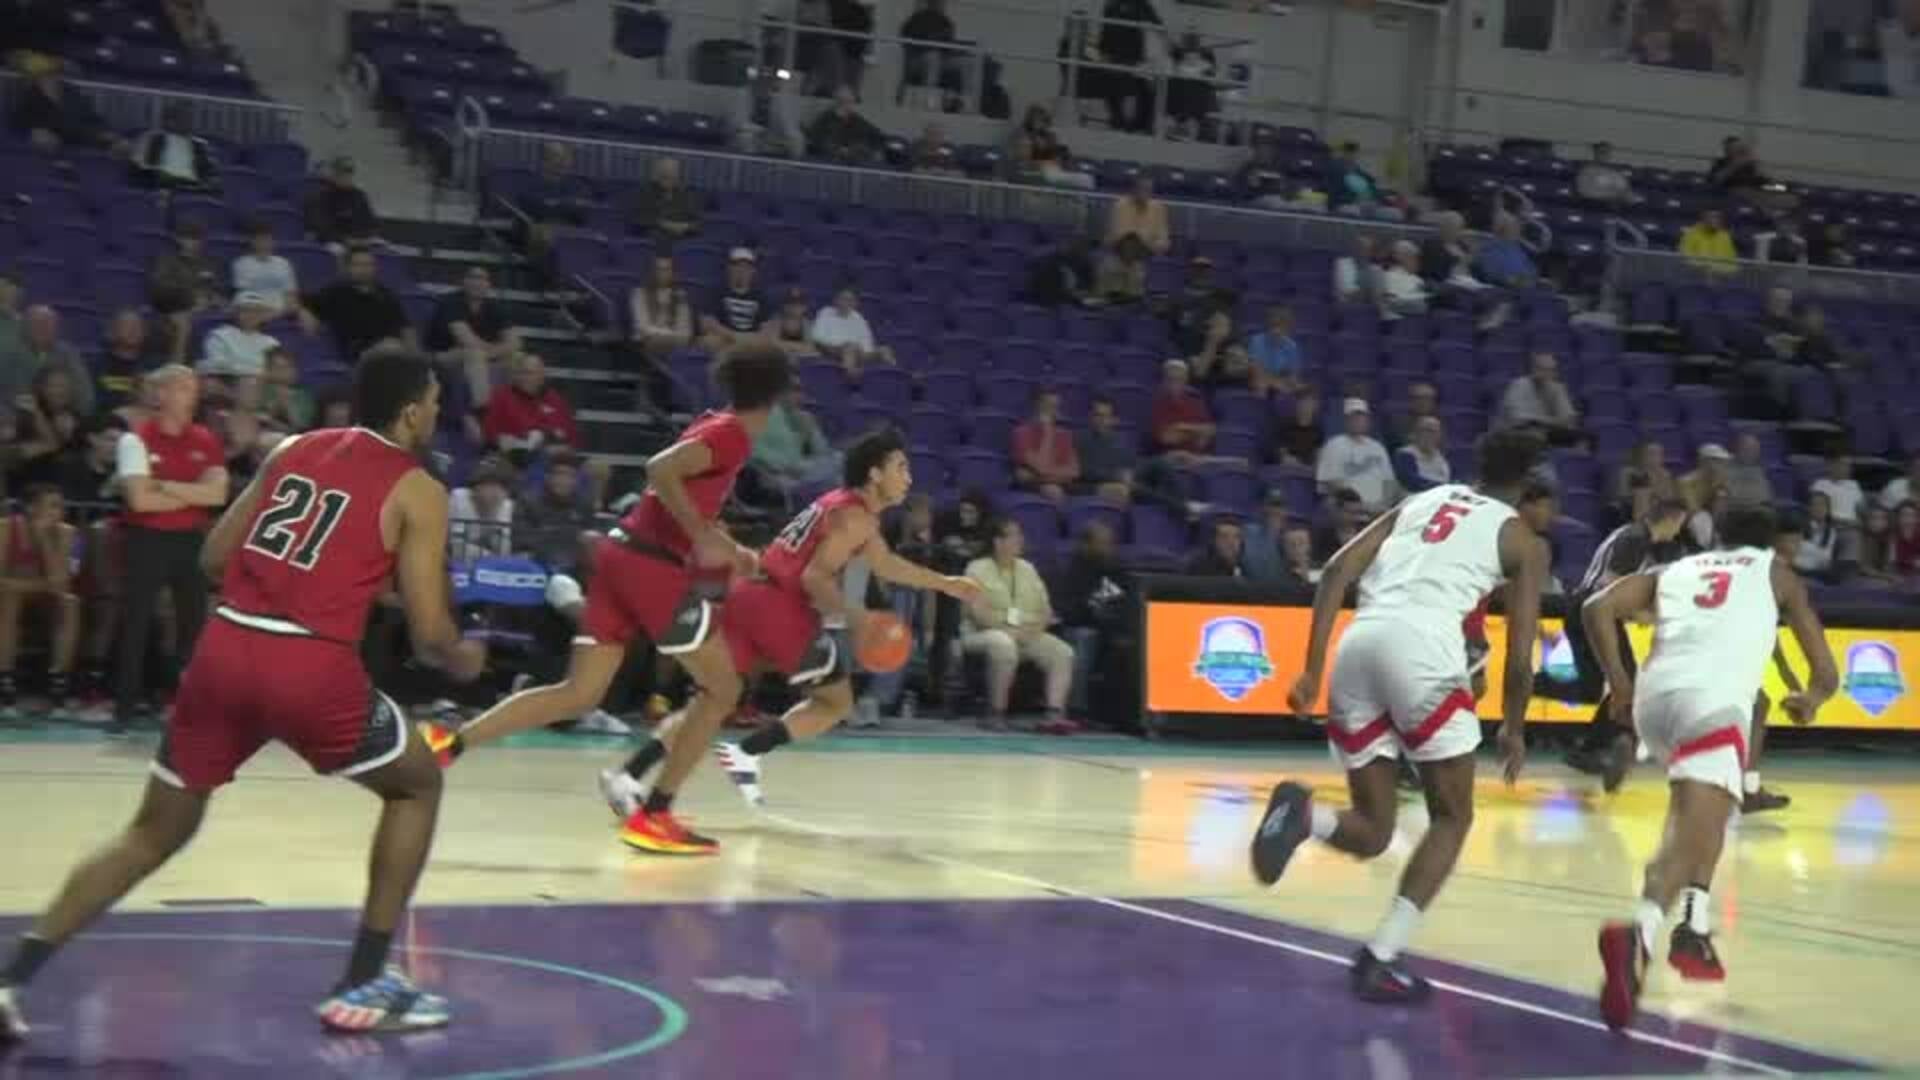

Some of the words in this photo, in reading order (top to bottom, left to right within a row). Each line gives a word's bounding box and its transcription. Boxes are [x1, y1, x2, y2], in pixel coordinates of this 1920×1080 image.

[244, 474, 351, 571] 21
[1421, 503, 1470, 544] 5
[1693, 570, 1733, 610] 3
